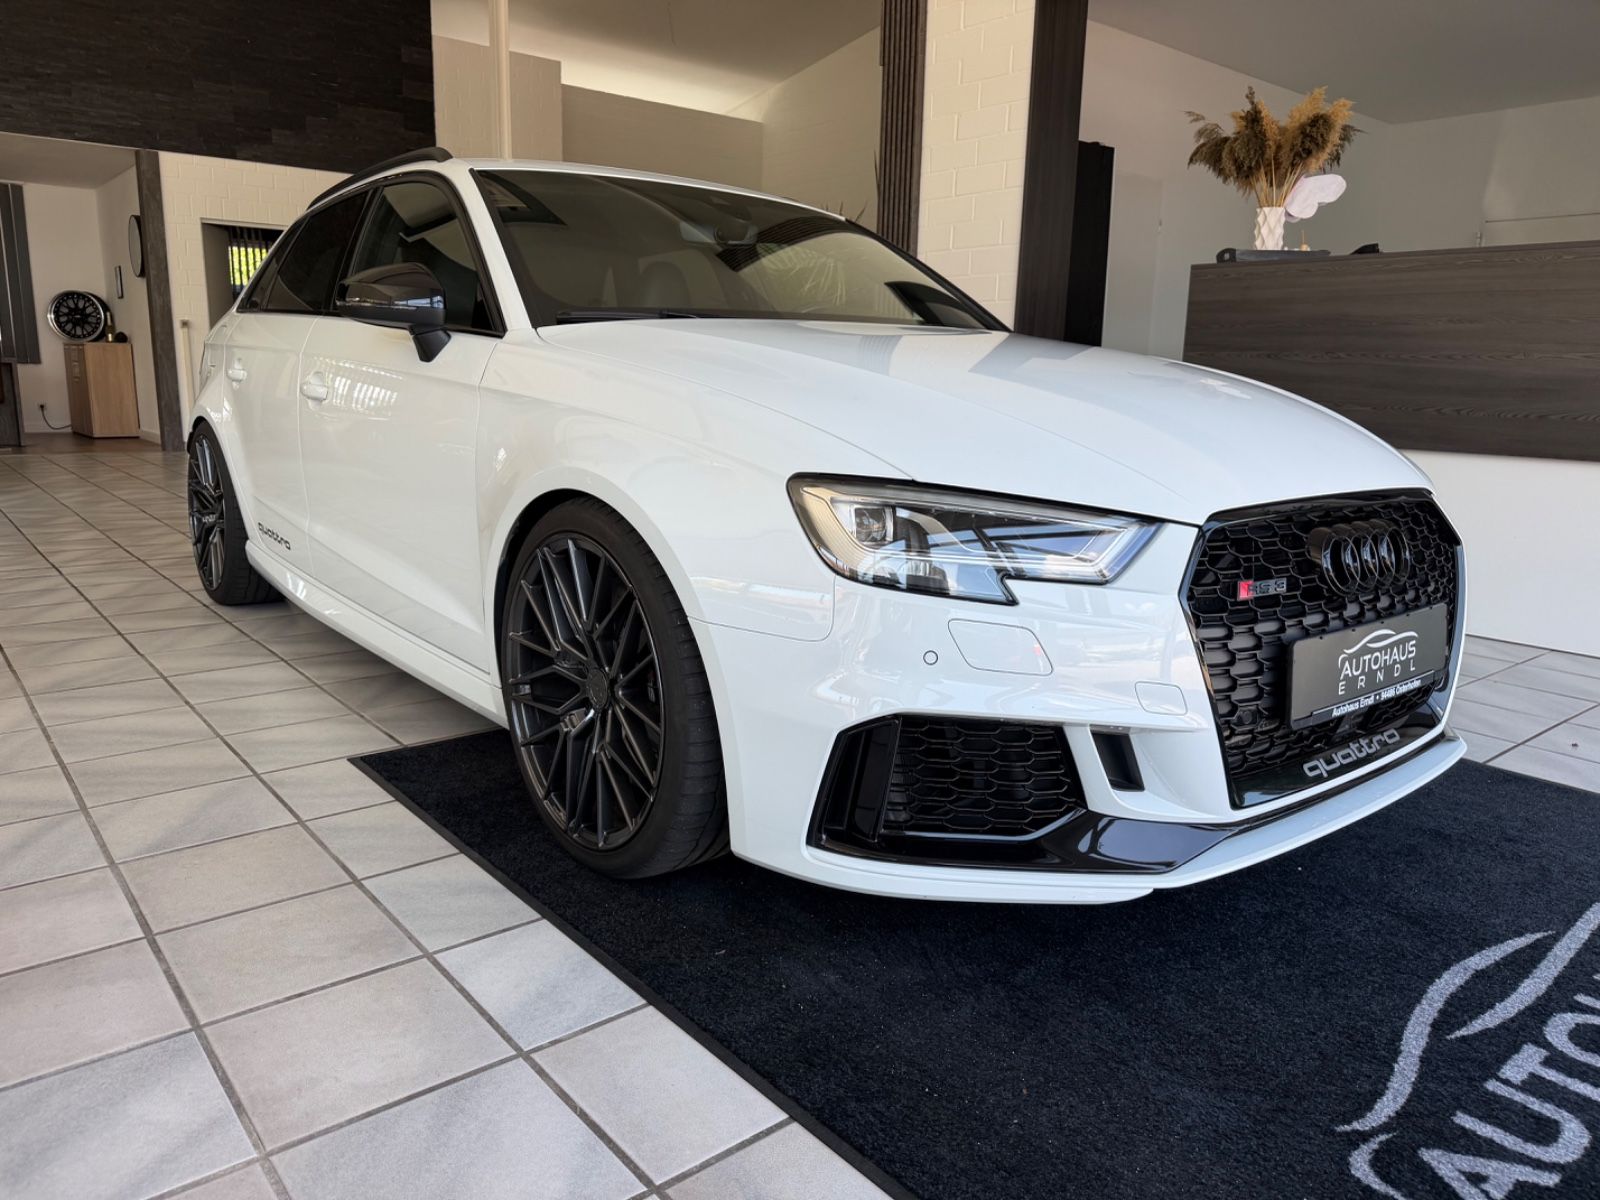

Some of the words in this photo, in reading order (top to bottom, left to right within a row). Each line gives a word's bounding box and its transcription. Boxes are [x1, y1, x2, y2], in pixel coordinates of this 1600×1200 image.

[257, 521, 292, 551] quattro
[1339, 640, 1416, 680] AUTOHAUS
[1332, 700, 1359, 717] Autohaus
[1360, 695, 1375, 708] Erndl
[1303, 728, 1400, 778] quattro
